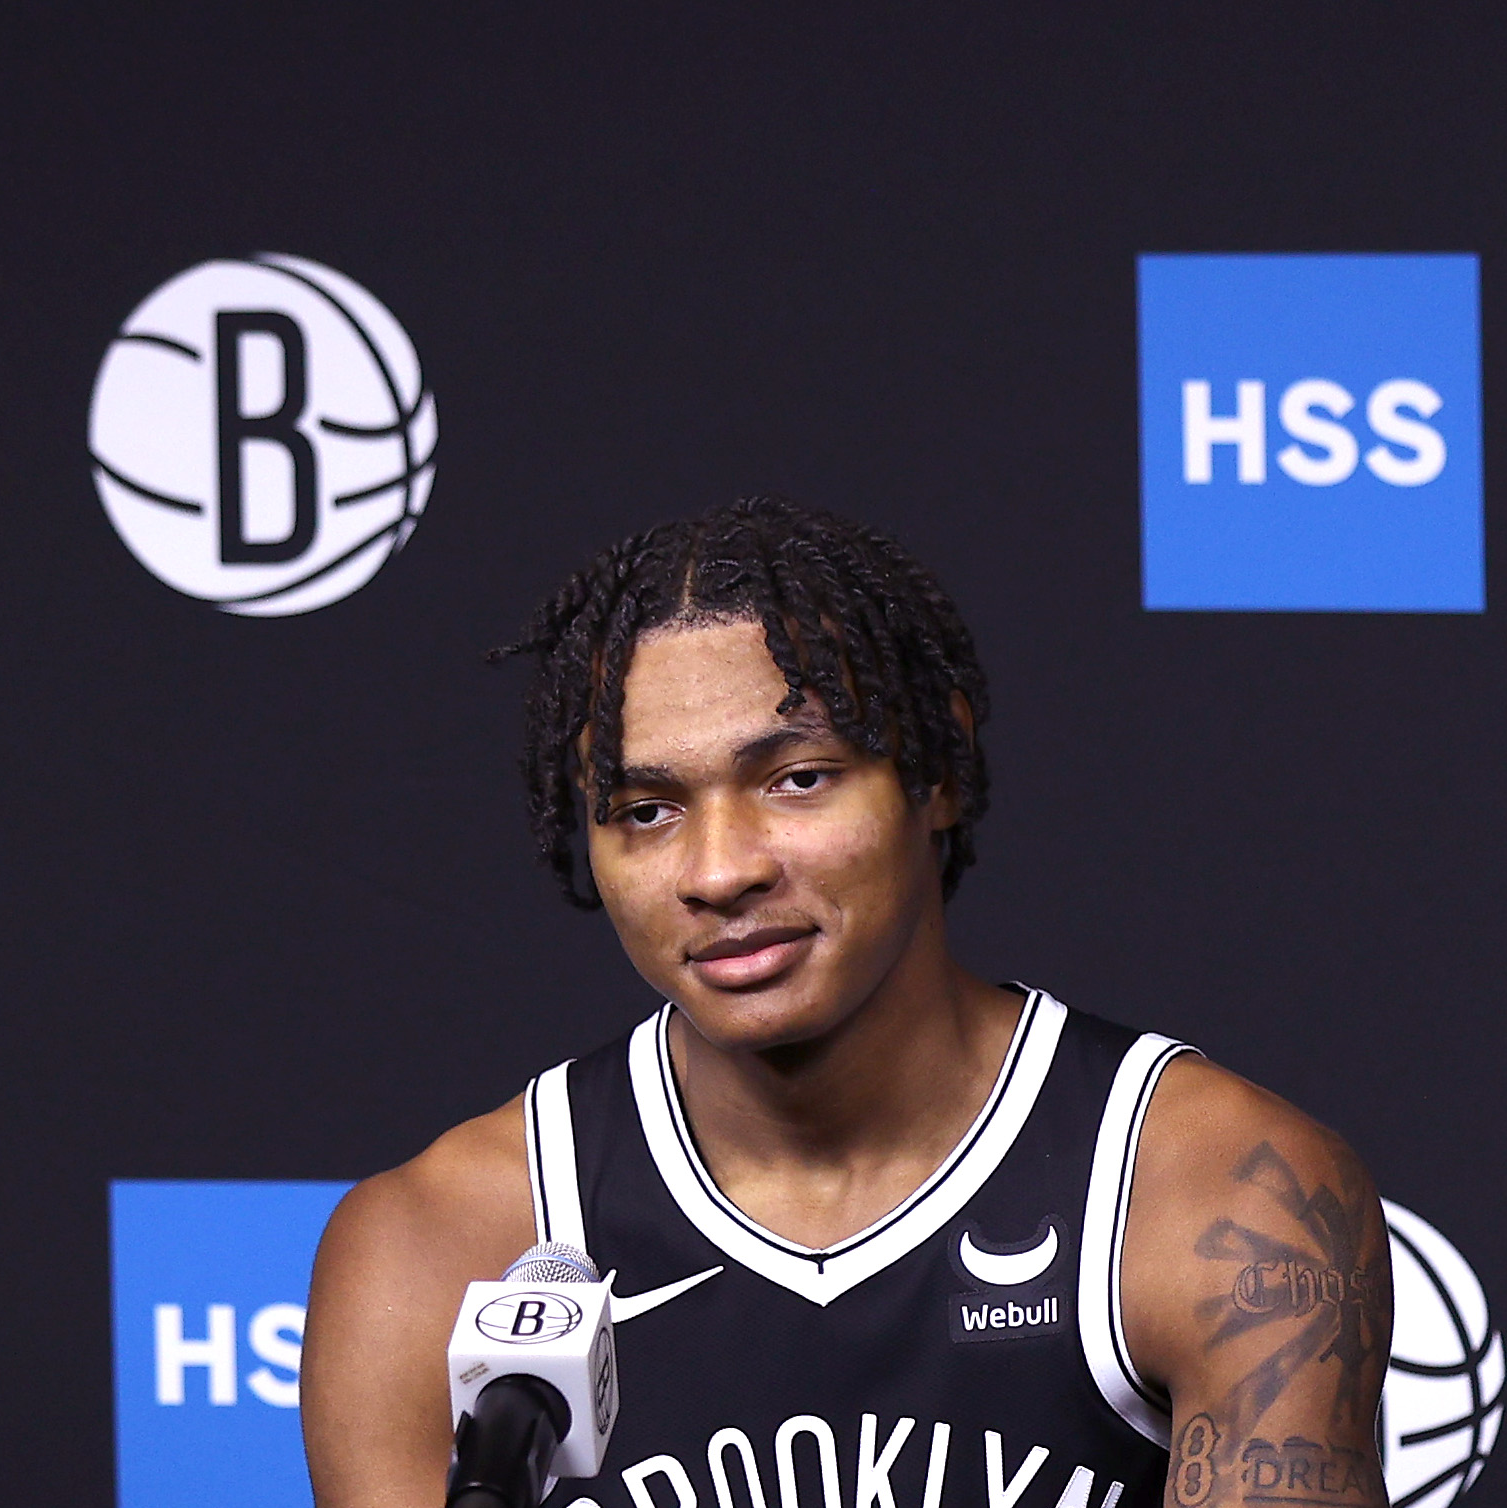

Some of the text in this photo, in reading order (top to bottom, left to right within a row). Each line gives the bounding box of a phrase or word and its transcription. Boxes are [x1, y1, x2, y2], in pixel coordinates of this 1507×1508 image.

[216, 311, 320, 564] B
[1181, 377, 1448, 488] HSS
[510, 1300, 547, 1336] B
[961, 1297, 1059, 1332] Webull
